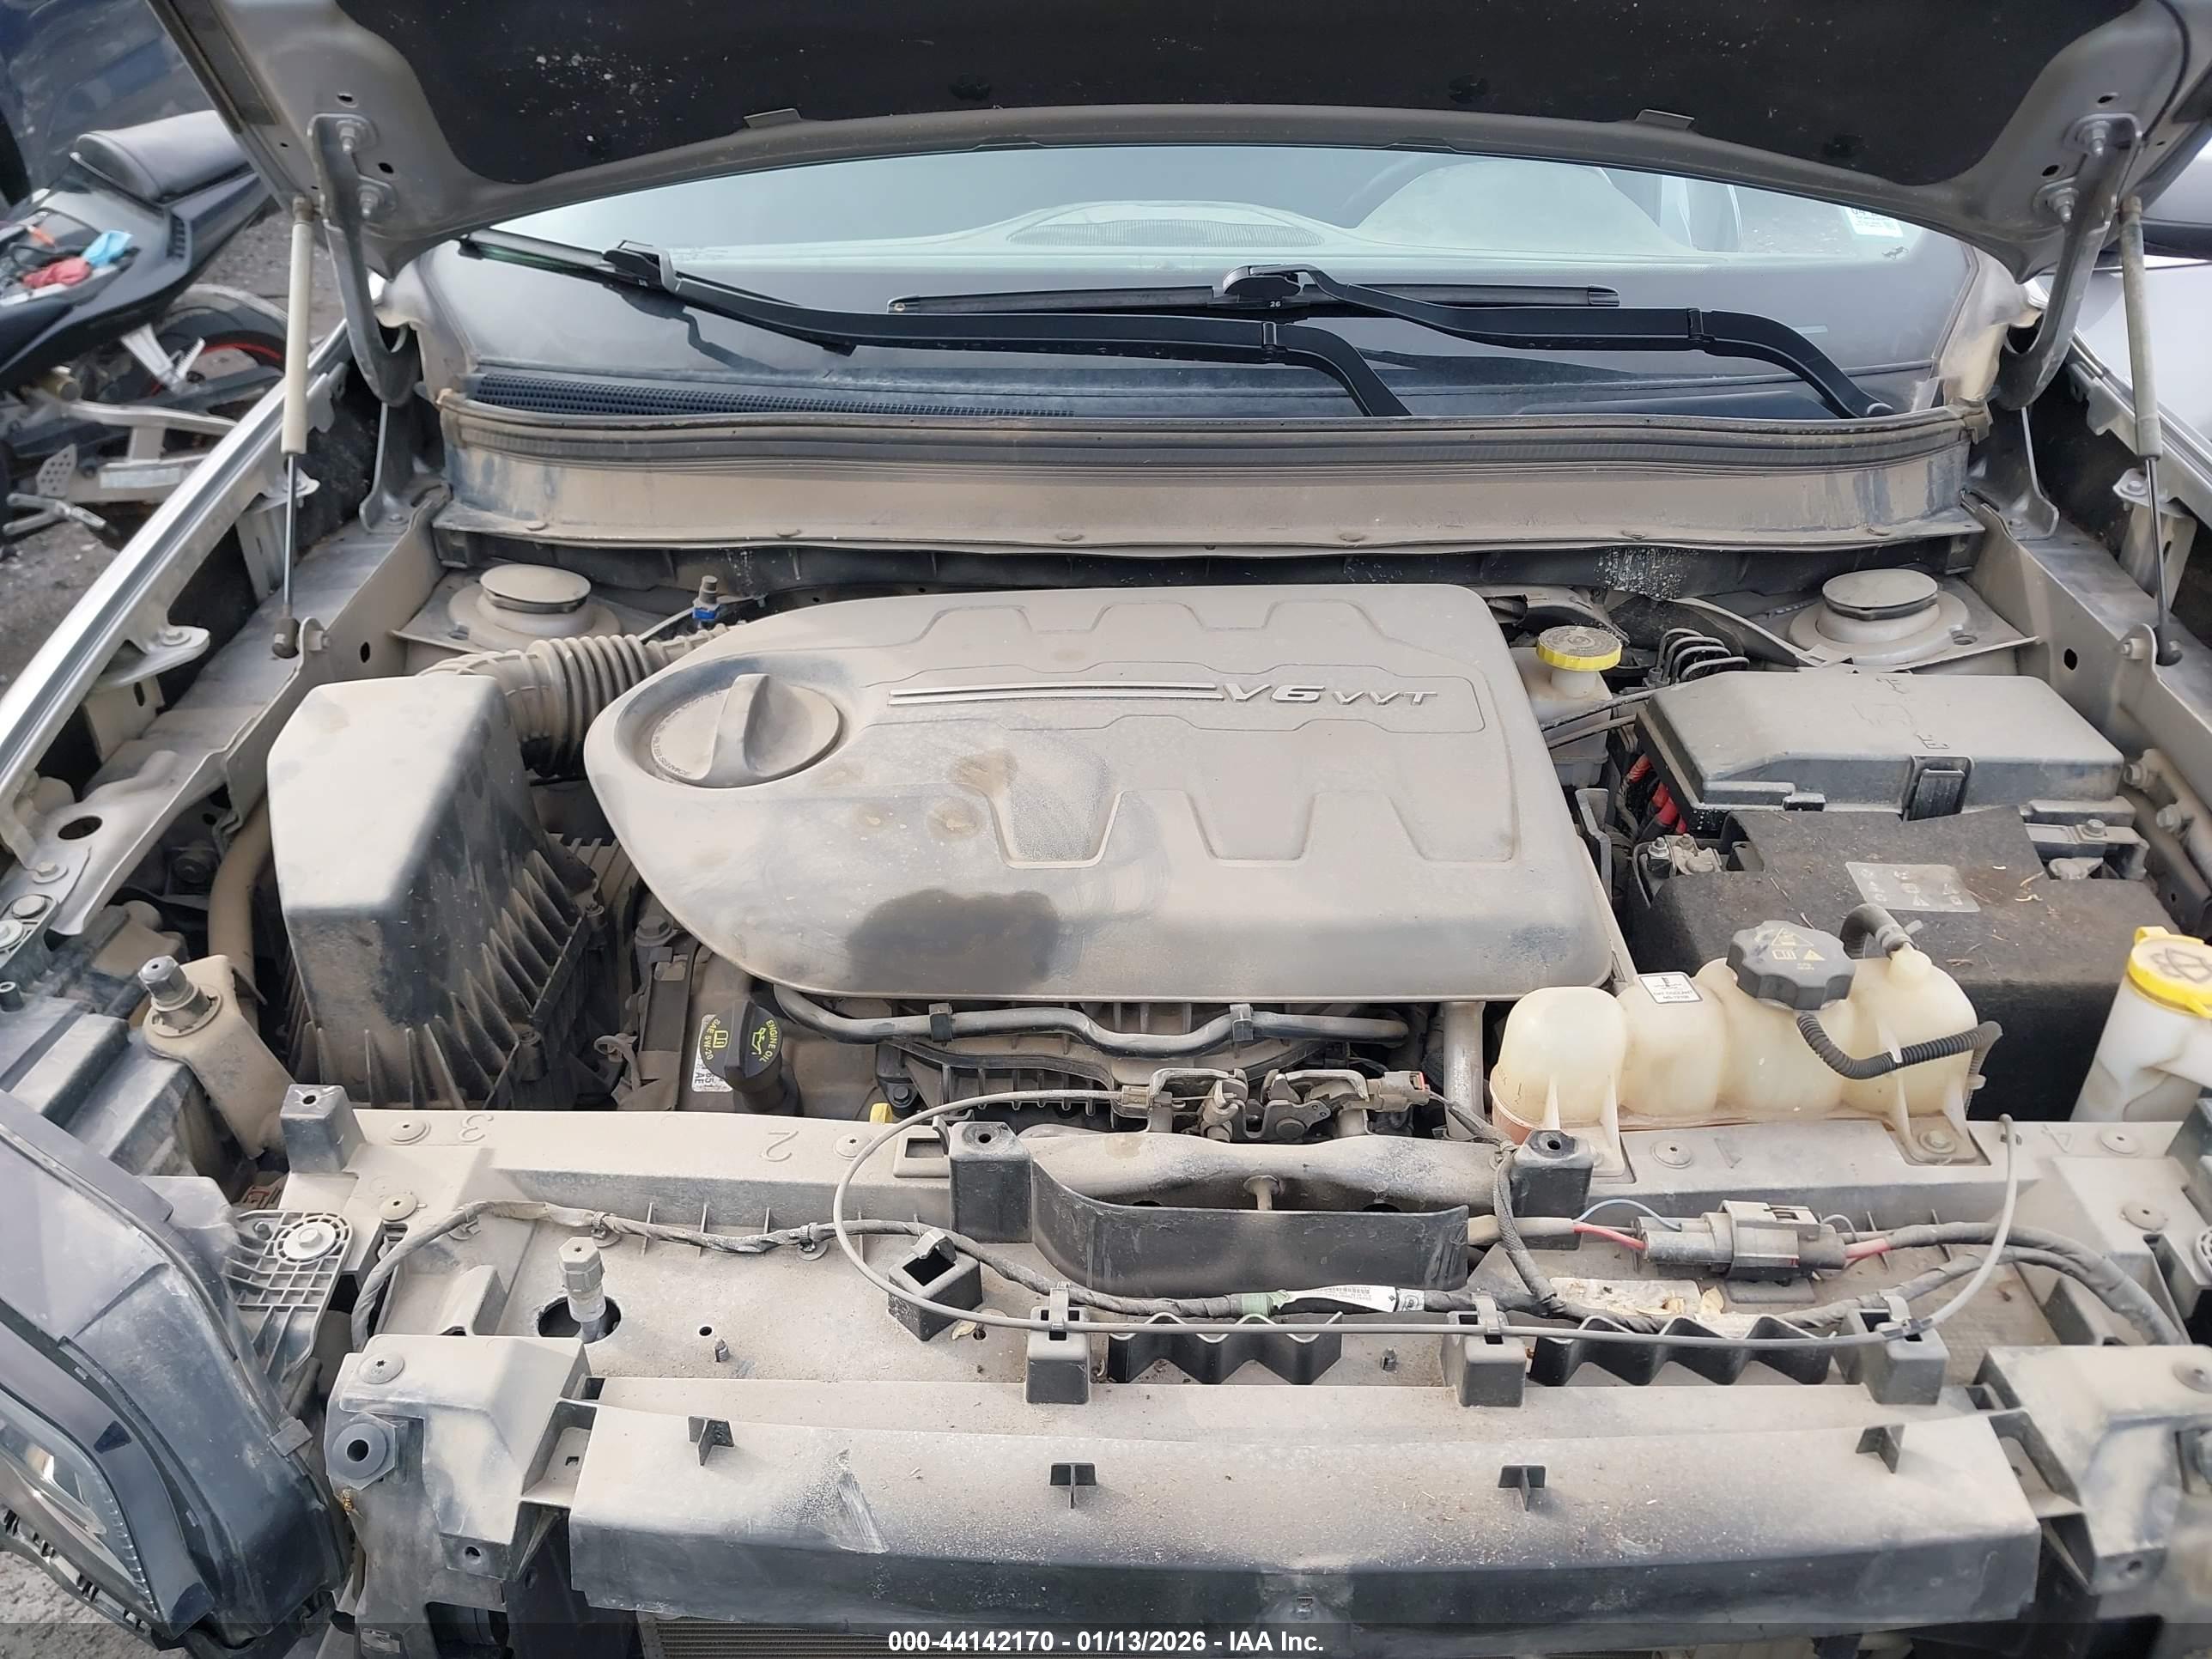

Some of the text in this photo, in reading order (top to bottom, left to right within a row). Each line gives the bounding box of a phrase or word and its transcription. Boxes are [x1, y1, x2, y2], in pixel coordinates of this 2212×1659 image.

[1223, 683, 1437, 706] V6 VVT
[707, 1018, 720, 1035] SAE
[759, 1019, 778, 1063] ENGINE OIL
